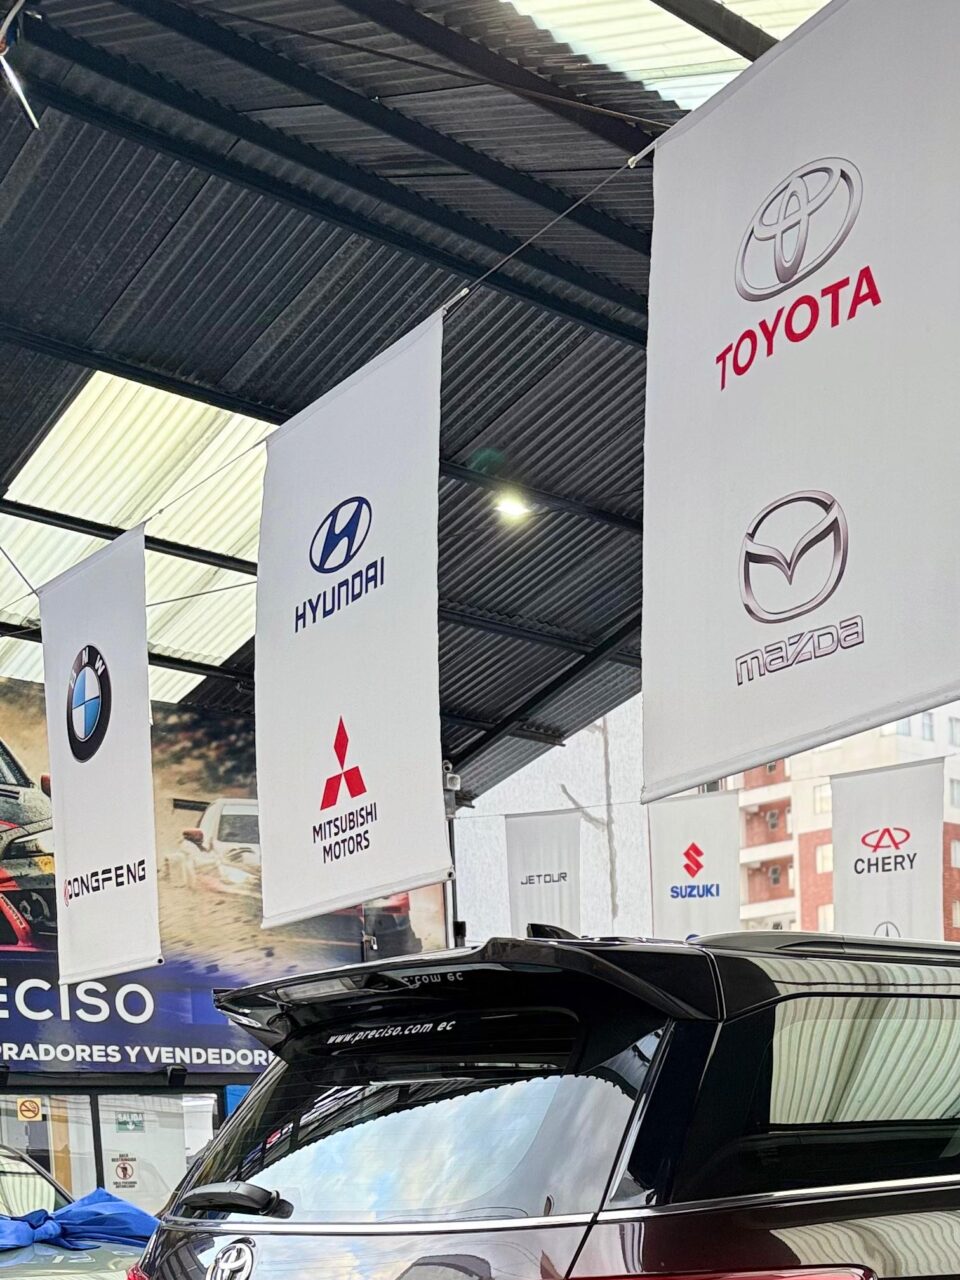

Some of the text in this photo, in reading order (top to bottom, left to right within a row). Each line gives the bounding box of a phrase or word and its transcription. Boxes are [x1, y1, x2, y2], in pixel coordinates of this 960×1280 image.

[715, 265, 882, 392] TOYOTA
[294, 556, 386, 633] HYUNDAI
[311, 802, 378, 844] MITSUBISHI
[322, 832, 371, 865] MOTORS
[853, 852, 918, 875] CHERY
[68, 859, 147, 900] DONGFENG
[520, 871, 568, 885] JETOUR
[670, 883, 720, 899] SUZUKI
[326, 1019, 457, 1045] www.preciso.com ec
[0, 1043, 121, 1063] RADORES
[125, 1046, 143, 1063] Y
[117, 1113, 143, 1122] SALIDA
